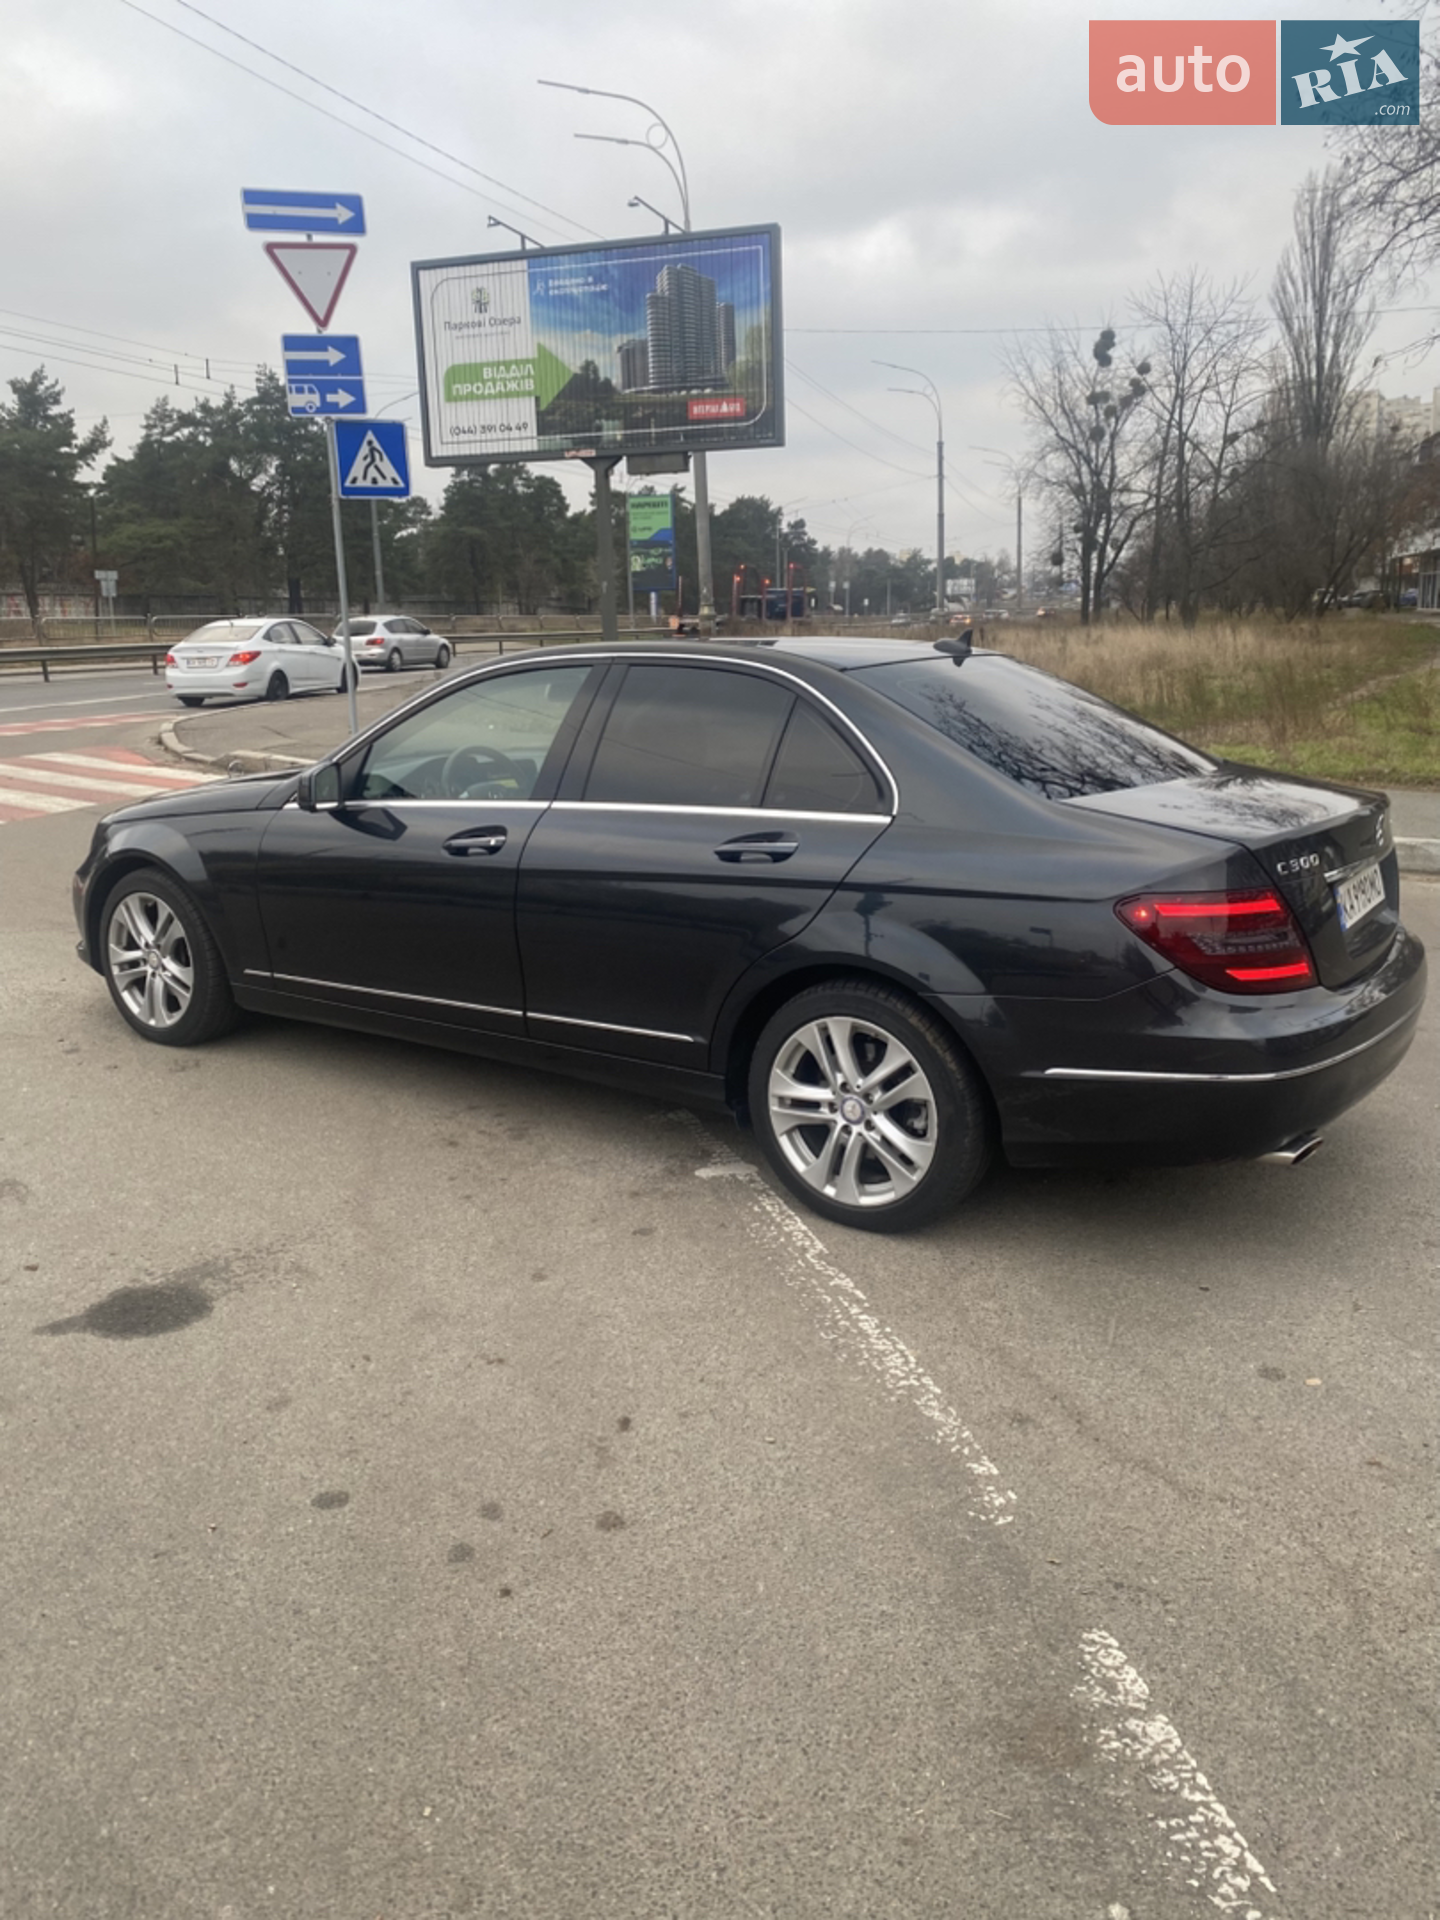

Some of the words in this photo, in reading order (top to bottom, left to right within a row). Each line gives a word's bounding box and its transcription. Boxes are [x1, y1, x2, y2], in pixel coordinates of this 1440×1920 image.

[482, 364, 534, 380] ВІДДІЛ
[452, 378, 534, 396] ПРОДАЖІВ
[450, 424, 477, 437] (044)
[480, 423, 497, 434] 391
[498, 423, 513, 433] 04
[515, 421, 528, 432] 49
